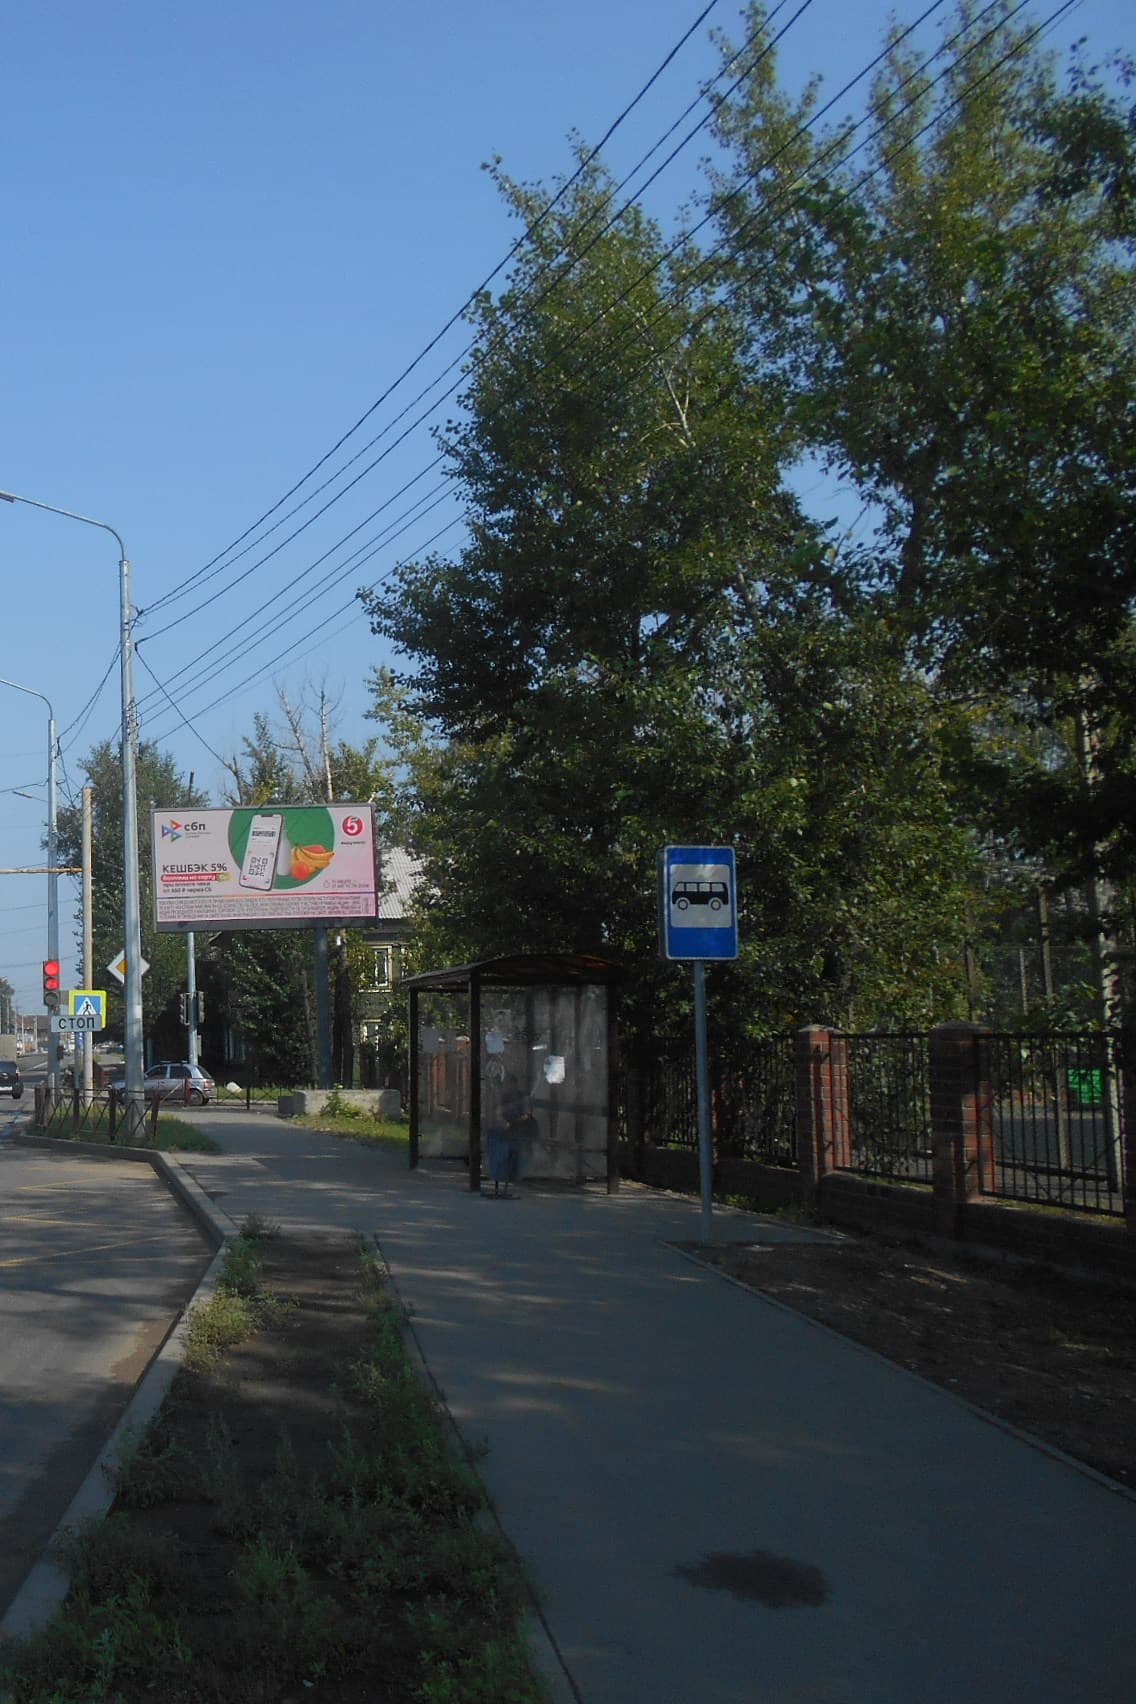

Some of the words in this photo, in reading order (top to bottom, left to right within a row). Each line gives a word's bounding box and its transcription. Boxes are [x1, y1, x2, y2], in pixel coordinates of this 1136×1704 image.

[184, 821, 206, 831] сбп
[346, 816, 359, 834] 5
[162, 864, 208, 873] КЕШБЭК
[211, 863, 228, 872] 5%
[58, 1017, 95, 1030] СТОП
